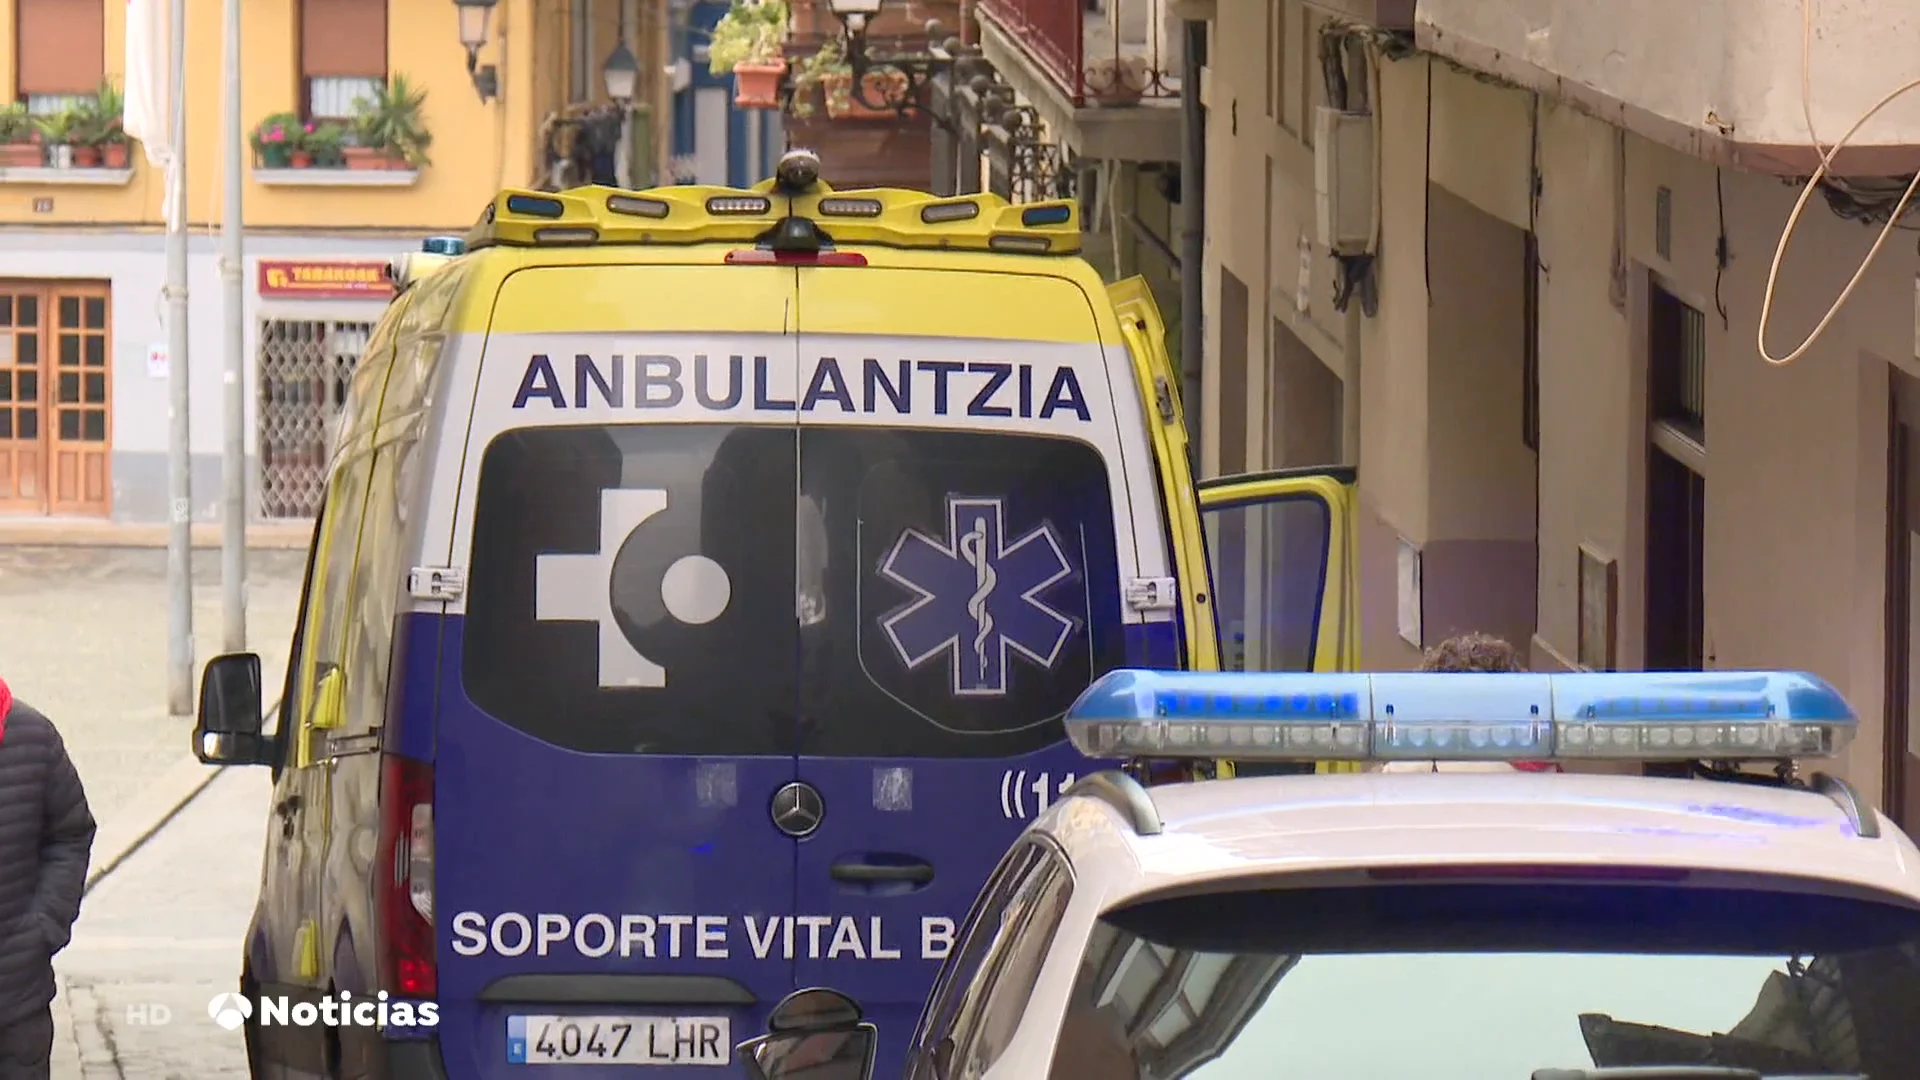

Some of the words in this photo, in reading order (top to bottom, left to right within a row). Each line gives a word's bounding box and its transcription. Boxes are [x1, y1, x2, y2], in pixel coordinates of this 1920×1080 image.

[512, 354, 1092, 421] ANBULANTZIA
[451, 912, 729, 959] SOPORTE
[744, 915, 901, 959] VITAL
[535, 1023, 632, 1058] 4047
[649, 1023, 720, 1058] LHR
